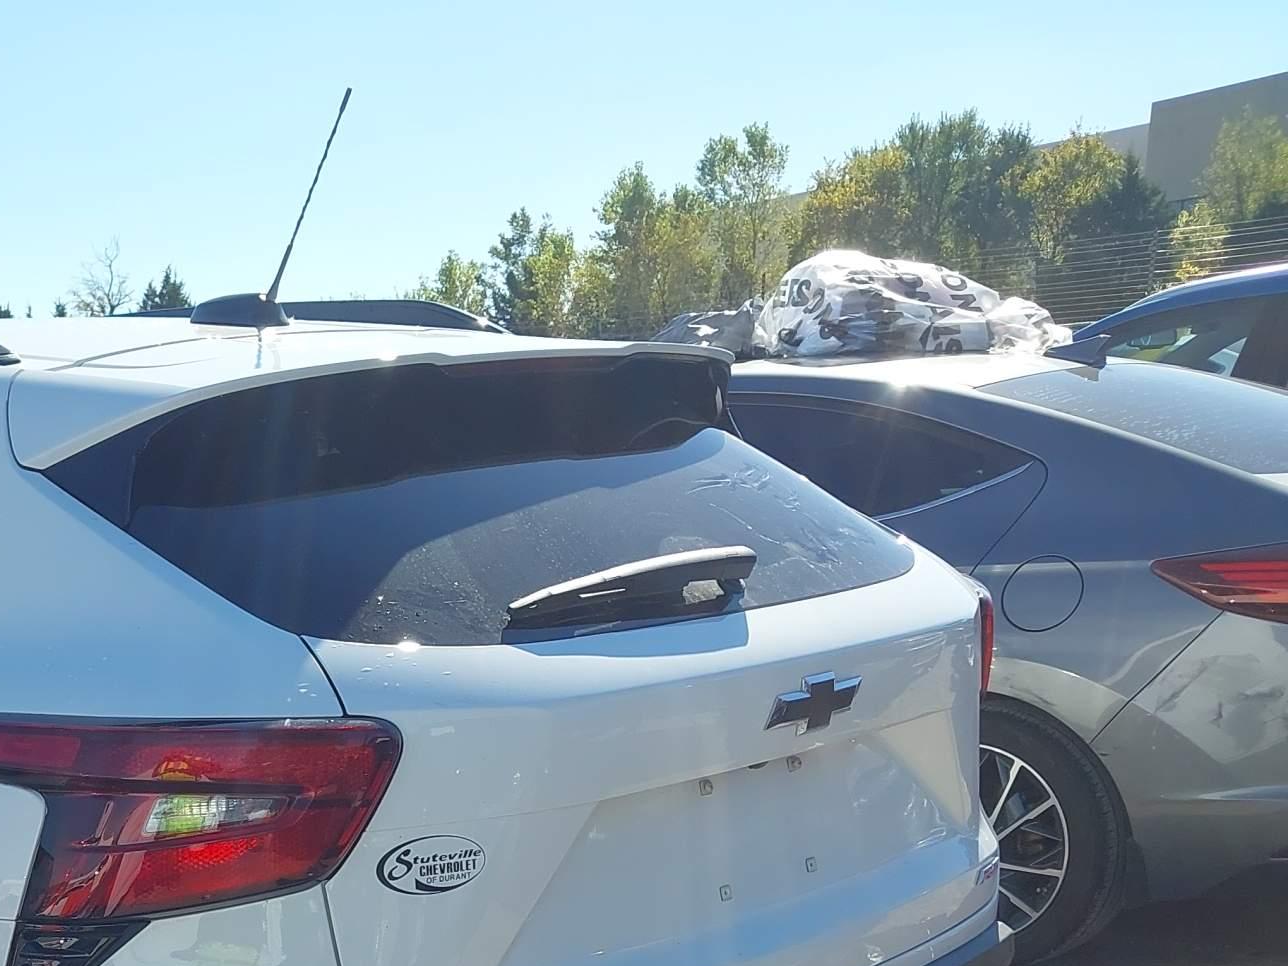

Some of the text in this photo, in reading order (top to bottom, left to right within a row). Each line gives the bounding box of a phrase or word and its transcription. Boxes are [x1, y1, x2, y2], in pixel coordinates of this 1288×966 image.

[387, 848, 482, 881] Stuteville
[419, 858, 477, 877] CHEVROLET
[426, 871, 472, 884] OF DURANT
